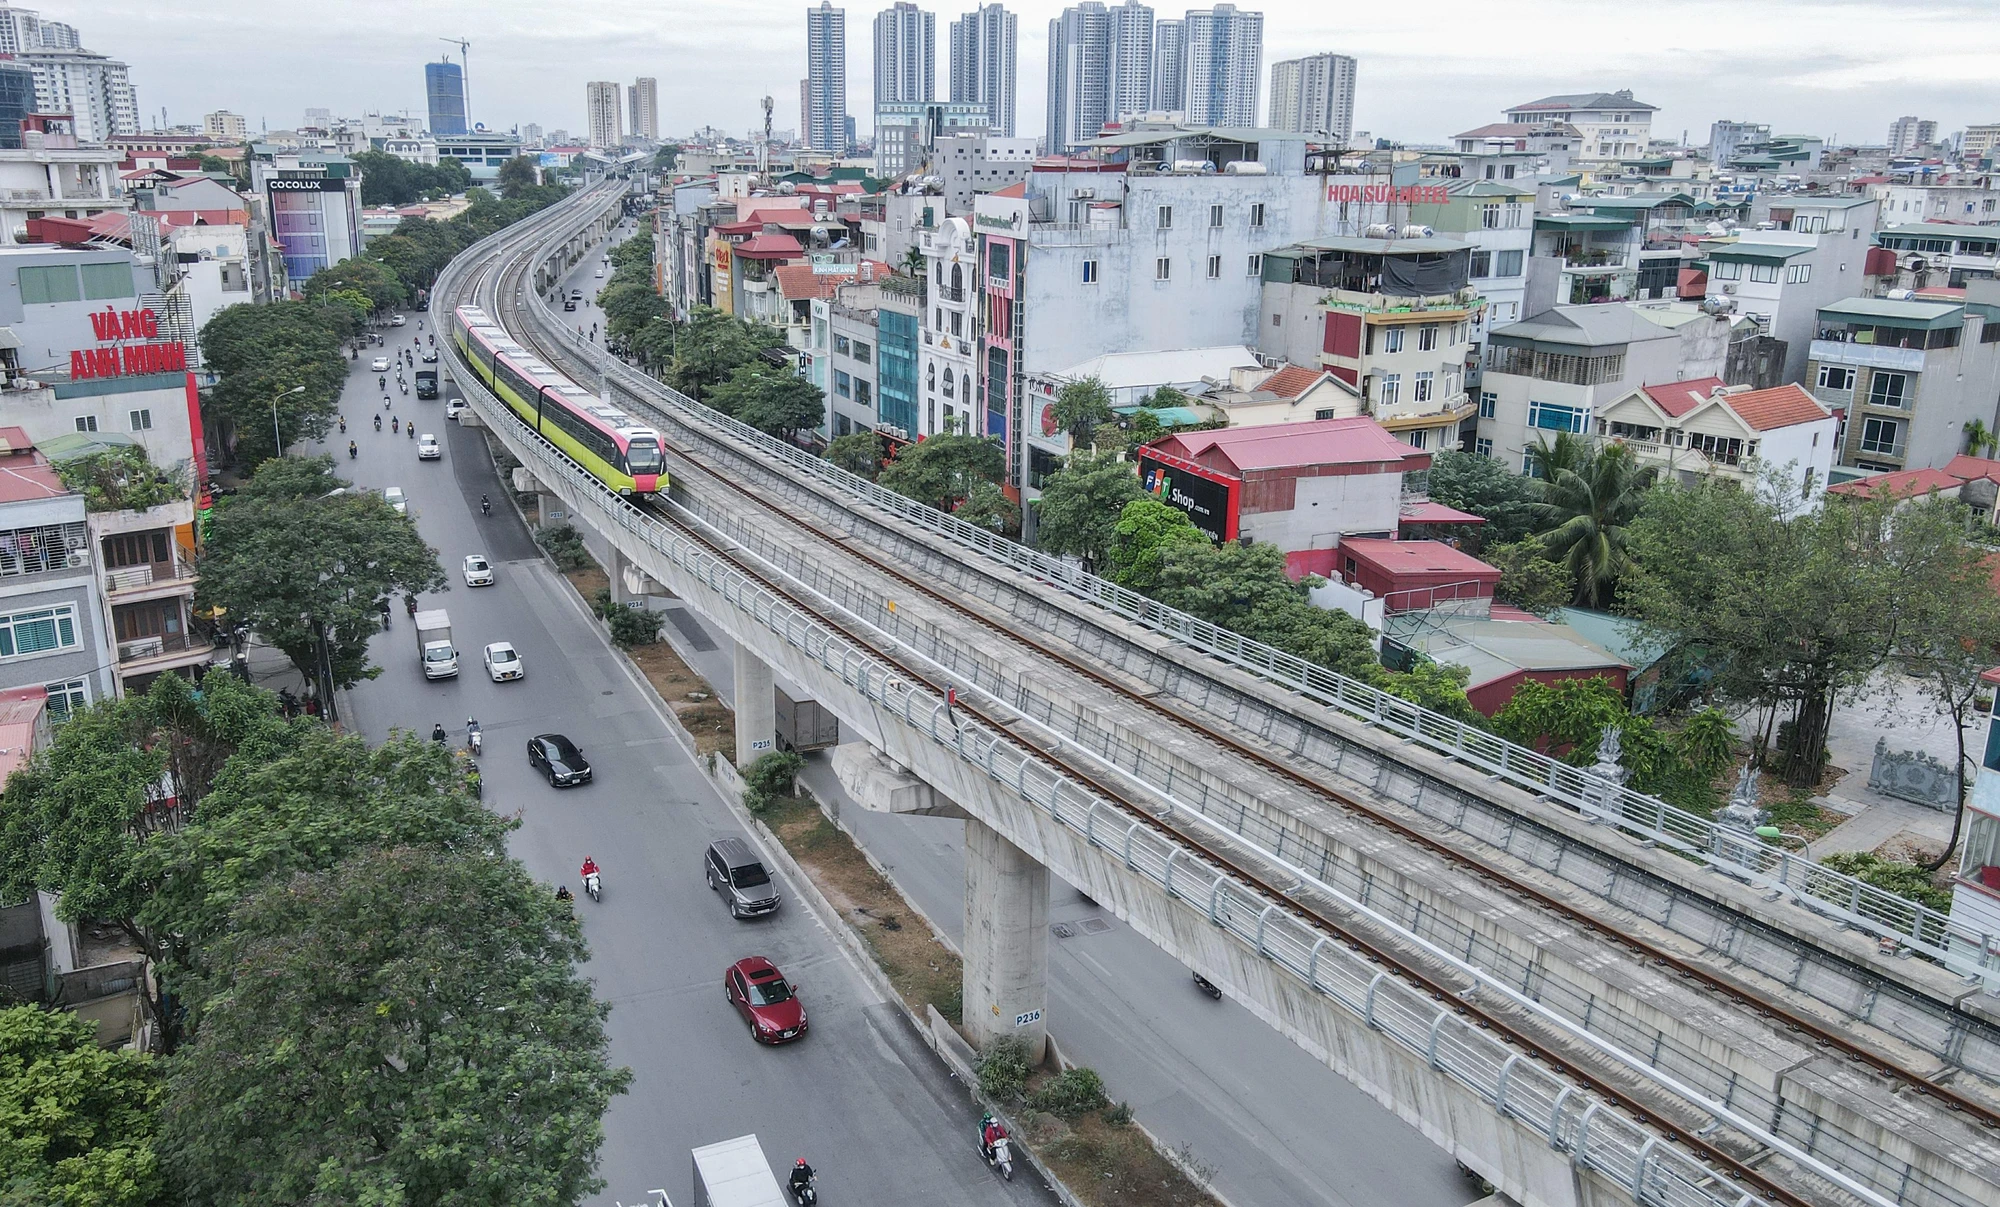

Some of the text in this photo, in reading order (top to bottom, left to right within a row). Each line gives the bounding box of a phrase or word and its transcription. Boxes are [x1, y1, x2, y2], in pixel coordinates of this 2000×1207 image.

[270, 181, 321, 190] COCOLUX
[1400, 186, 1450, 204] HOTEL
[88, 305, 158, 341] VÀNG
[71, 341, 186, 381] ANH MINH
[1145, 473, 1170, 495] FPT
[1172, 488, 1195, 511] Shop
[753, 740, 771, 749] P235
[1016, 1010, 1040, 1026] P236
